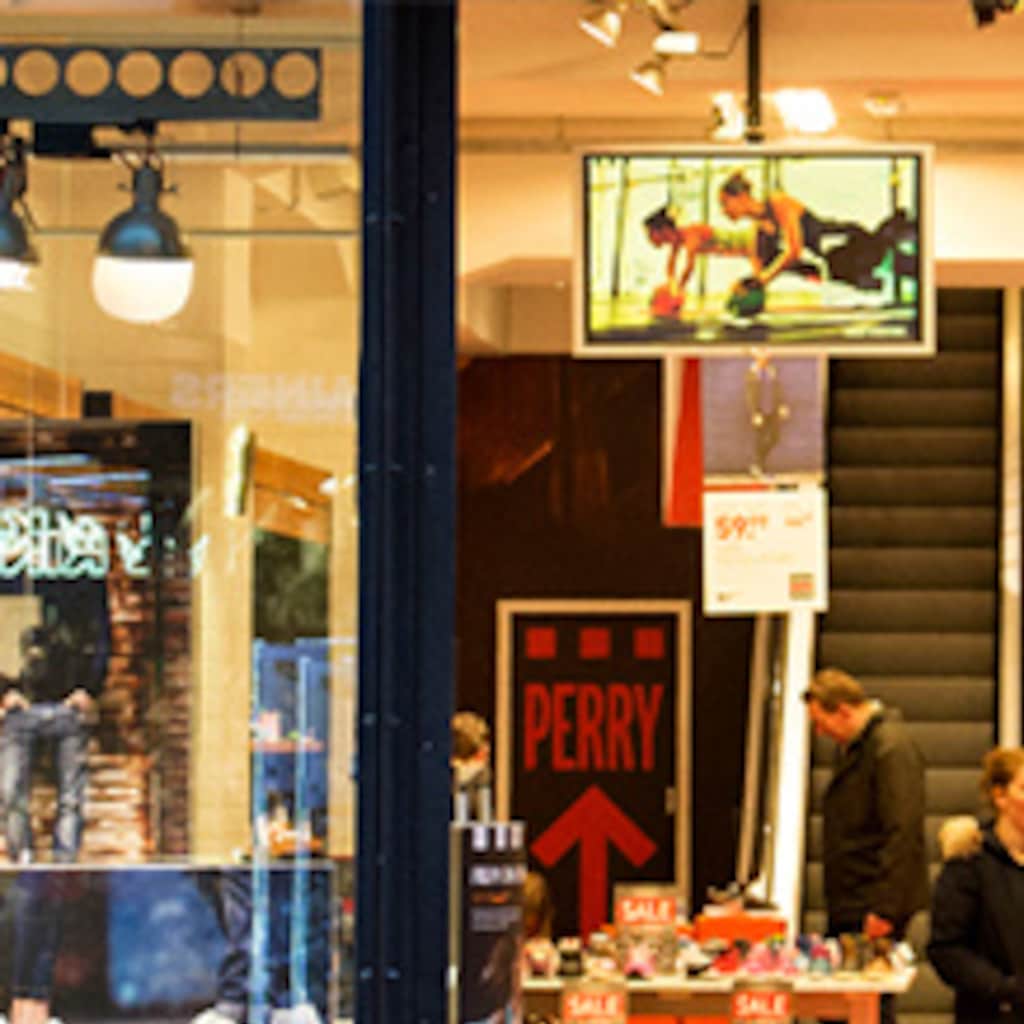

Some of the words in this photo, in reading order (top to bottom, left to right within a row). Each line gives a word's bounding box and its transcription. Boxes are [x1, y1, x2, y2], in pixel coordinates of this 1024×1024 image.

[523, 682, 665, 772] PERRY
[621, 898, 673, 922] SALE
[567, 994, 620, 1018] SALE
[736, 993, 788, 1017] SALE
